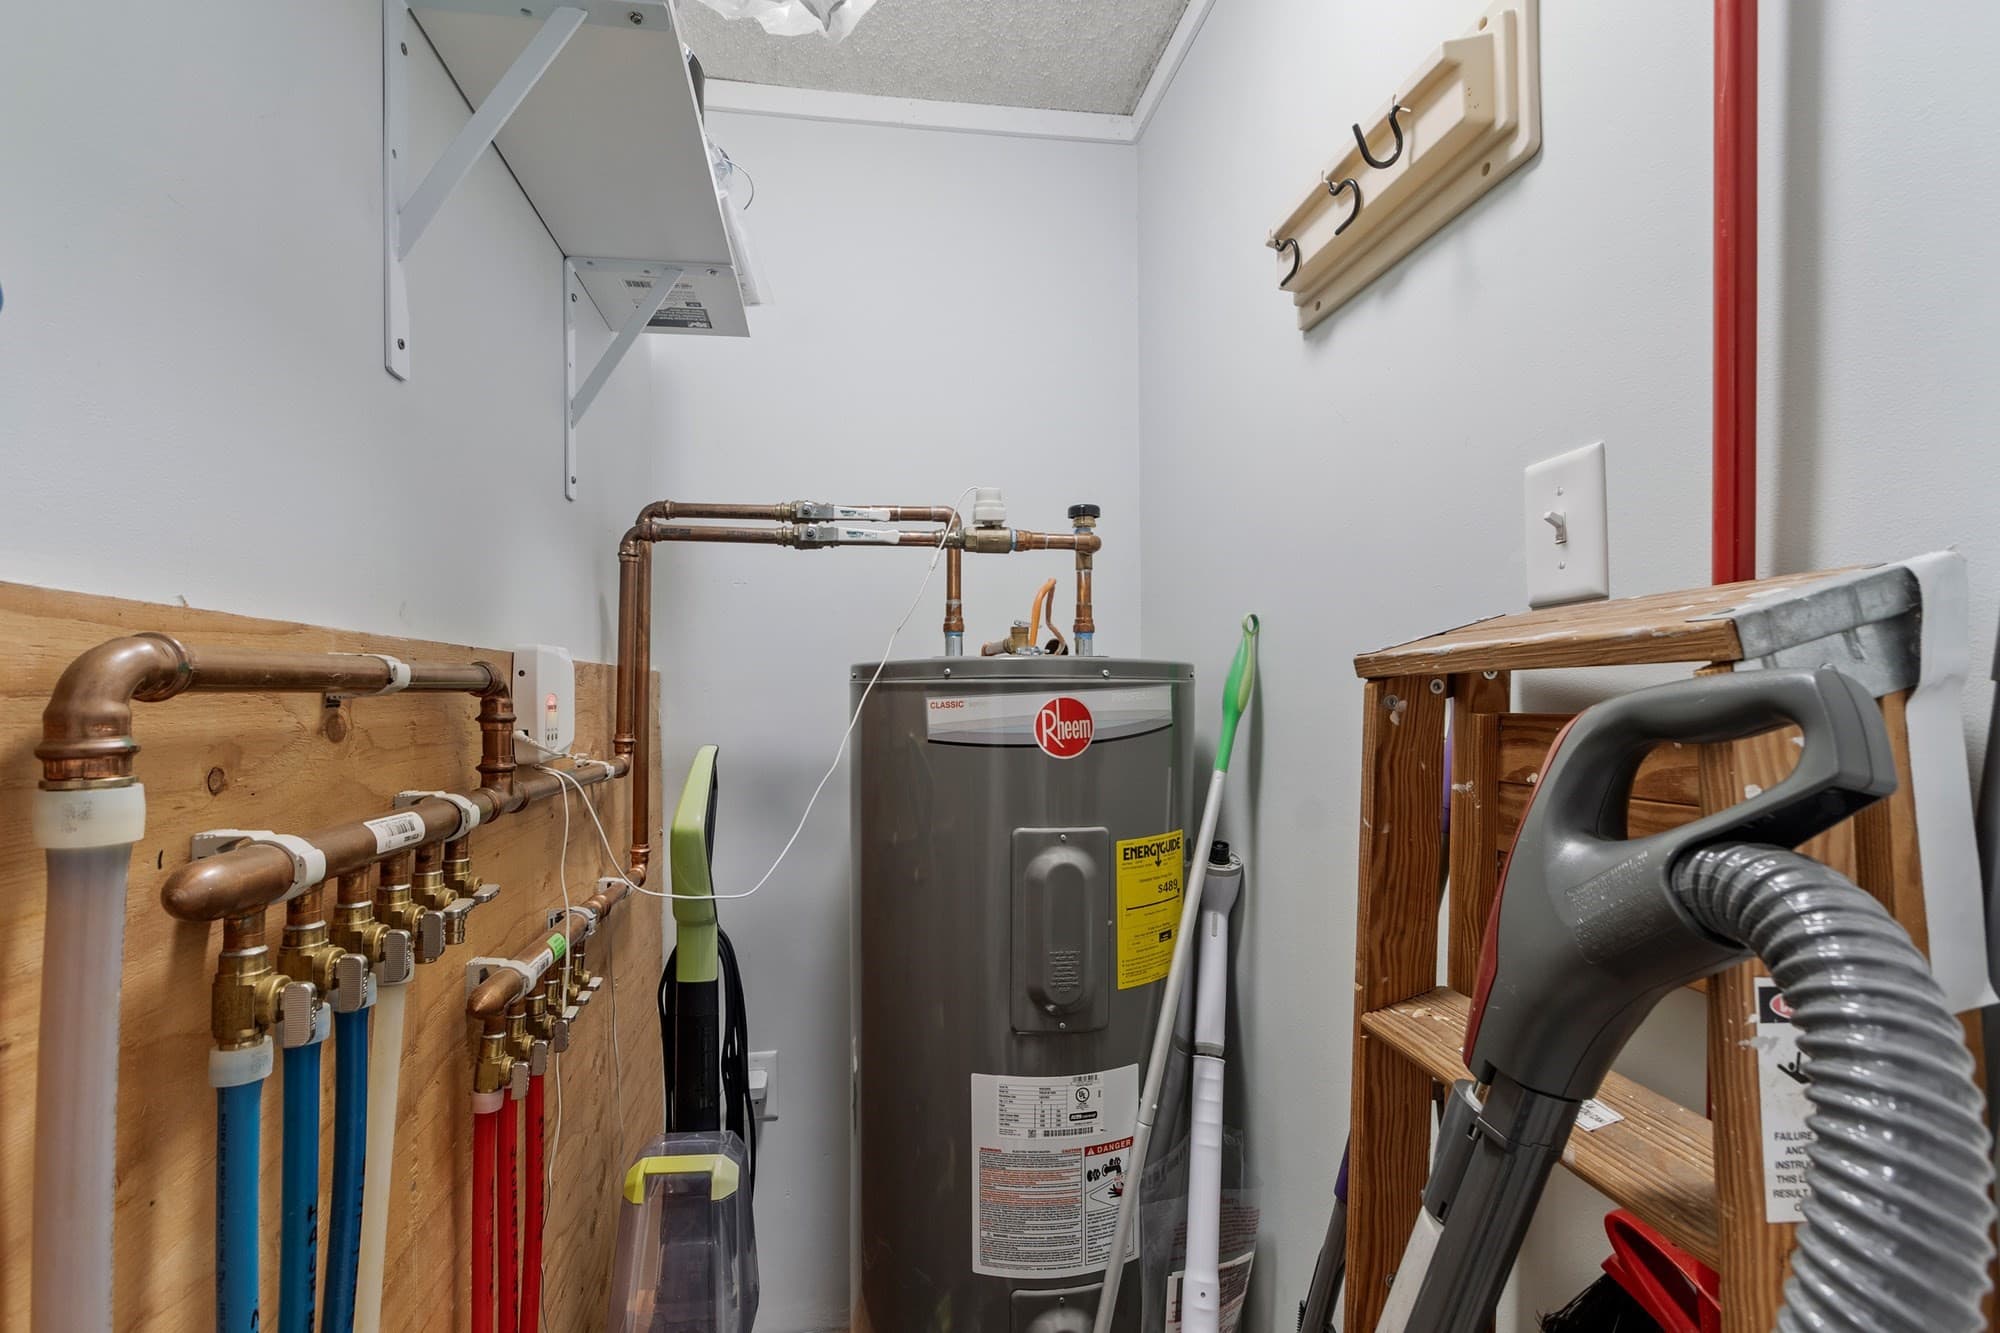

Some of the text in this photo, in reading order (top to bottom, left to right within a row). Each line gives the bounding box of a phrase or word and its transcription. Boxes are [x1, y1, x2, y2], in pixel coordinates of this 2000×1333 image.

[929, 700, 964, 710] CLASSIC
[1041, 698, 1091, 749] Rheem
[1123, 837, 1181, 861] ENERGYGUIDE
[1773, 1131, 1813, 1141] FAILURE
[1096, 1139, 1132, 1154] DANGER
[1785, 1146, 1807, 1155] AND
[1774, 1160, 1810, 1169] INSTRU
[1775, 1174, 1797, 1184] THIS
[1772, 1188, 1809, 1198] RESULT
